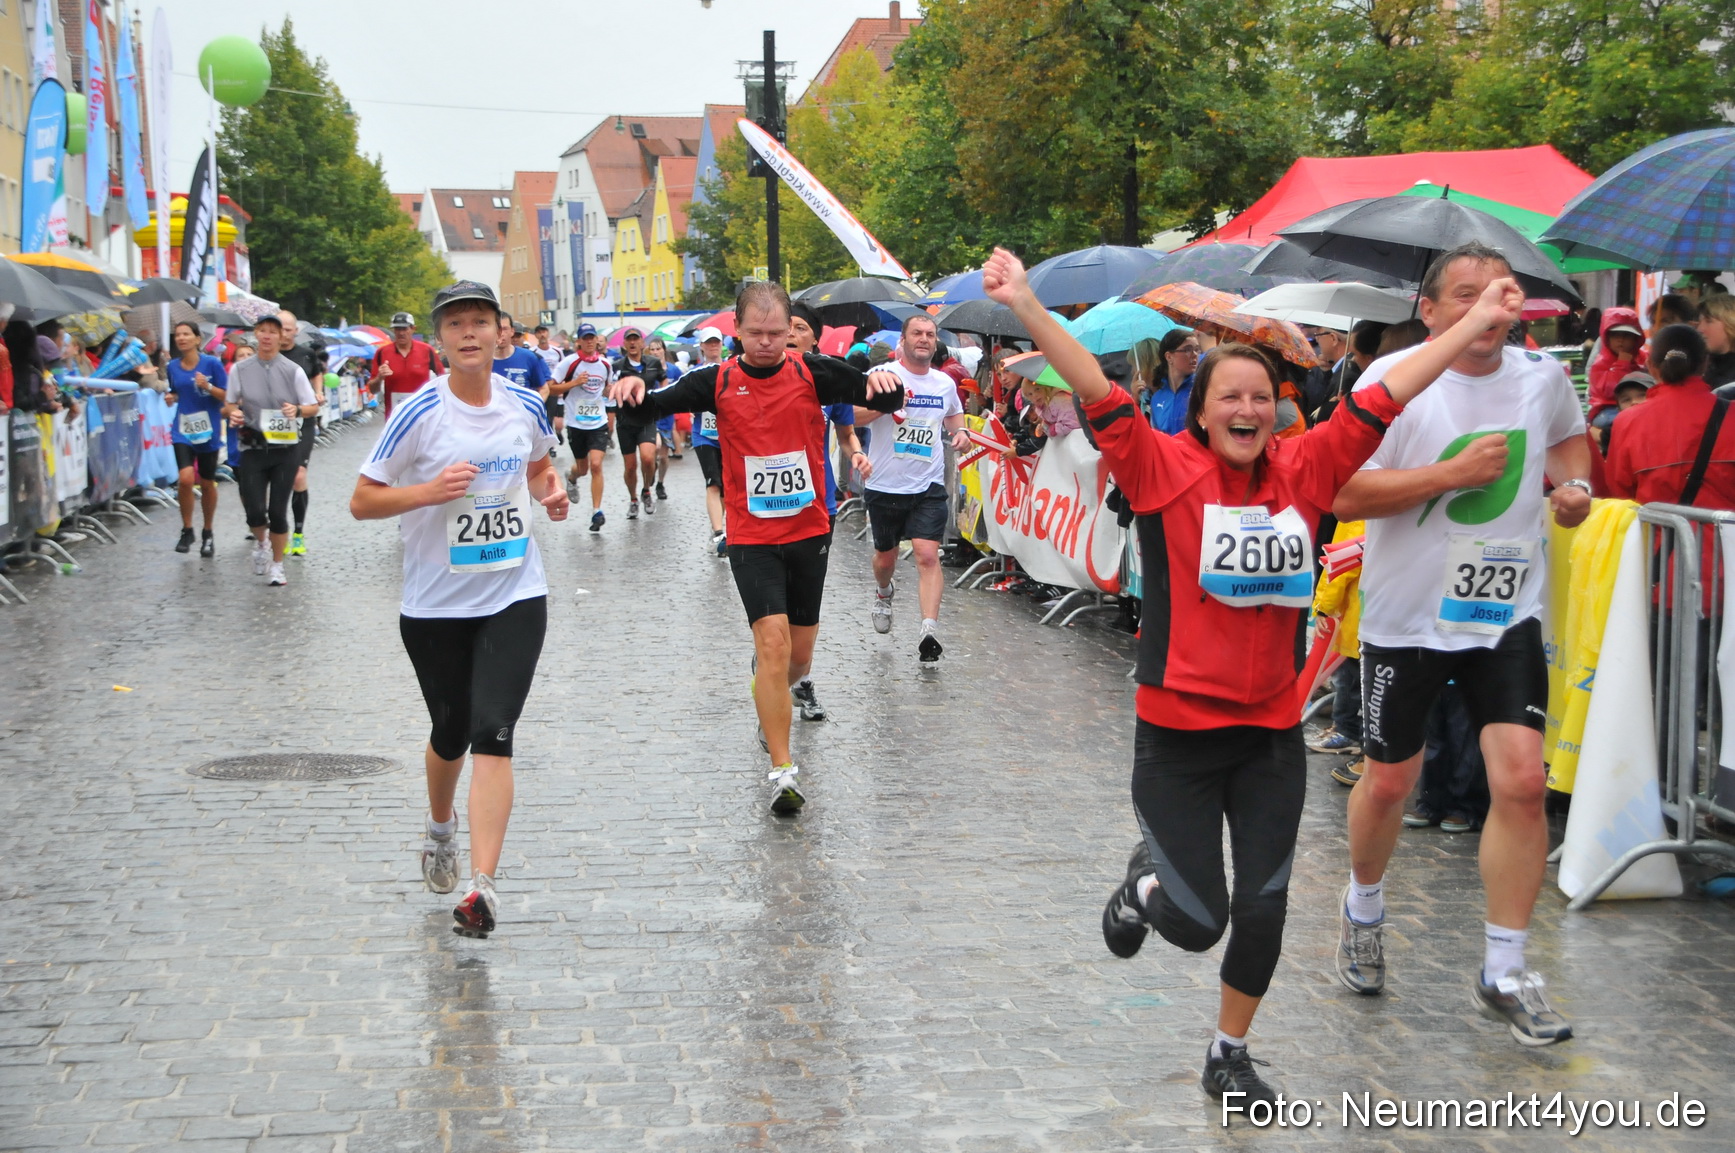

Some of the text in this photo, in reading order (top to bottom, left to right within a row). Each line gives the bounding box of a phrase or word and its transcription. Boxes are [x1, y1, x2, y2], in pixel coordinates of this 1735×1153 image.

[907, 397, 942, 406] TAEDTLER
[577, 406, 600, 416] 3272
[897, 427, 933, 445] 2402
[905, 445, 921, 454] Sepp
[753, 468, 806, 495] 2793
[474, 494, 507, 505] BOCK
[764, 497, 800, 508] Wilfried
[1240, 513, 1272, 524] BOC
[457, 507, 524, 543] 2435
[480, 547, 507, 561] Anita
[1213, 532, 1304, 573] 2609
[1483, 546, 1522, 556] BOCK
[1231, 581, 1284, 597] yvonne
[1470, 606, 1509, 622] Josef
